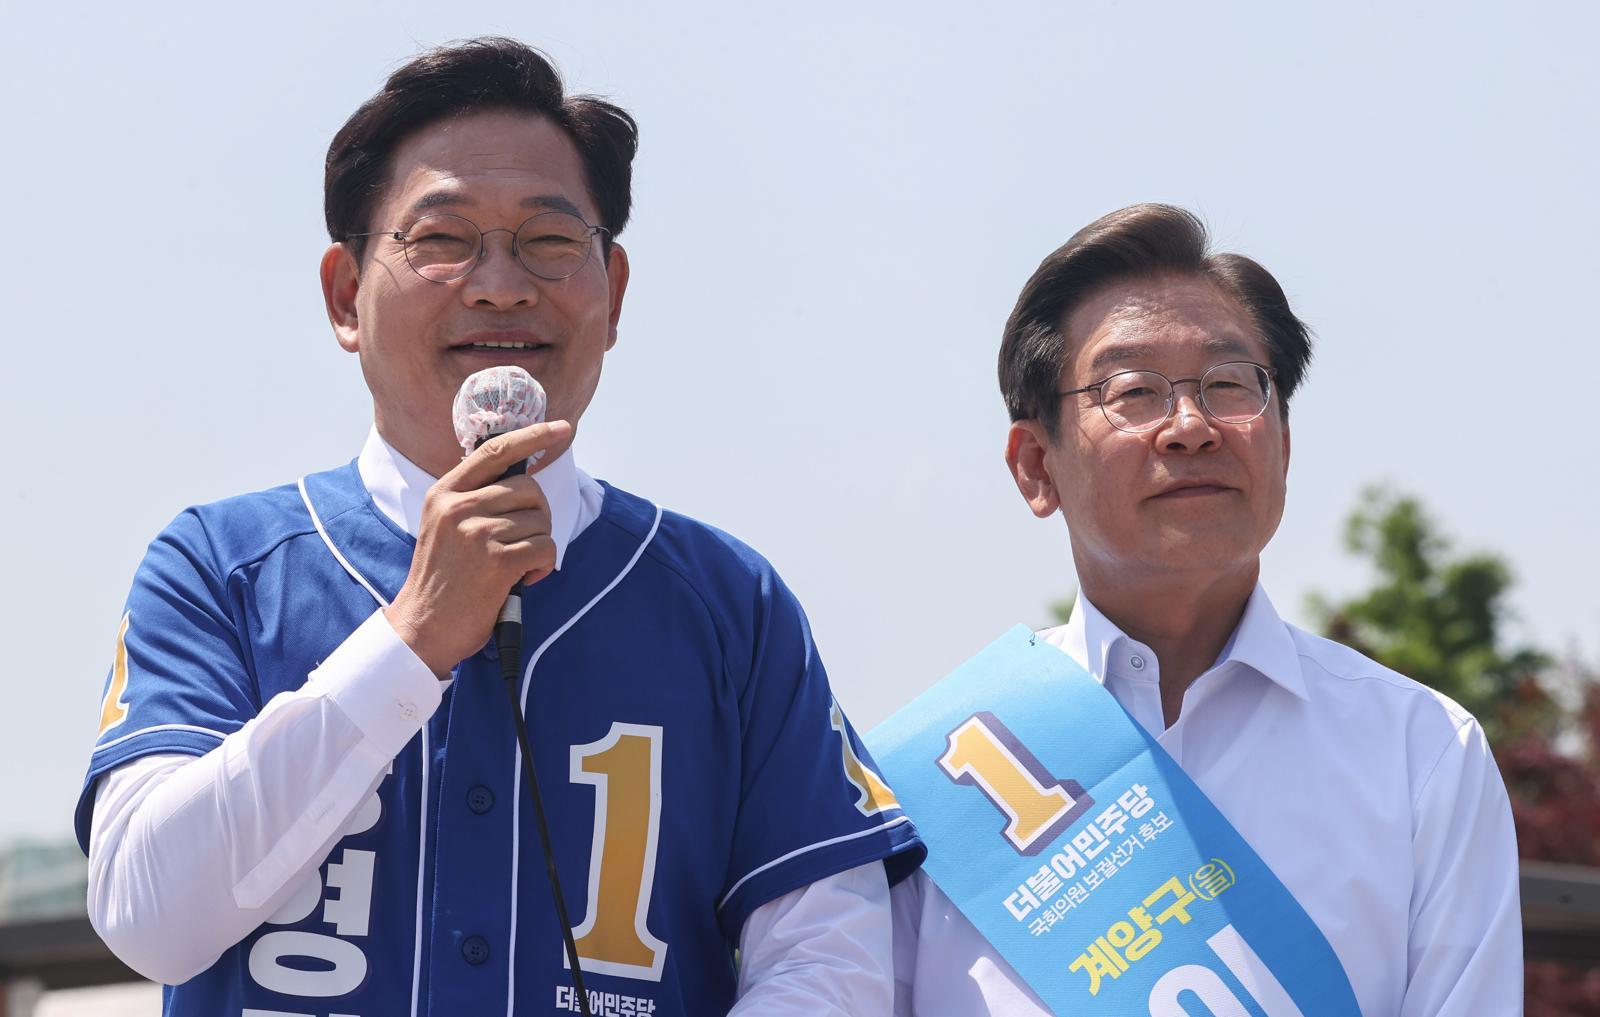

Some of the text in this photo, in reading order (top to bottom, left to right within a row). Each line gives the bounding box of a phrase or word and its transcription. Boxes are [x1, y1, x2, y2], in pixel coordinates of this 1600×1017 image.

[564, 721, 668, 983] 1
[934, 711, 1095, 857] 1
[1002, 783, 1155, 922] 더불어민주당
[1028, 811, 1174, 936] 국회의원 보궐선거 후보
[1068, 858, 1235, 996] 계양구(을)
